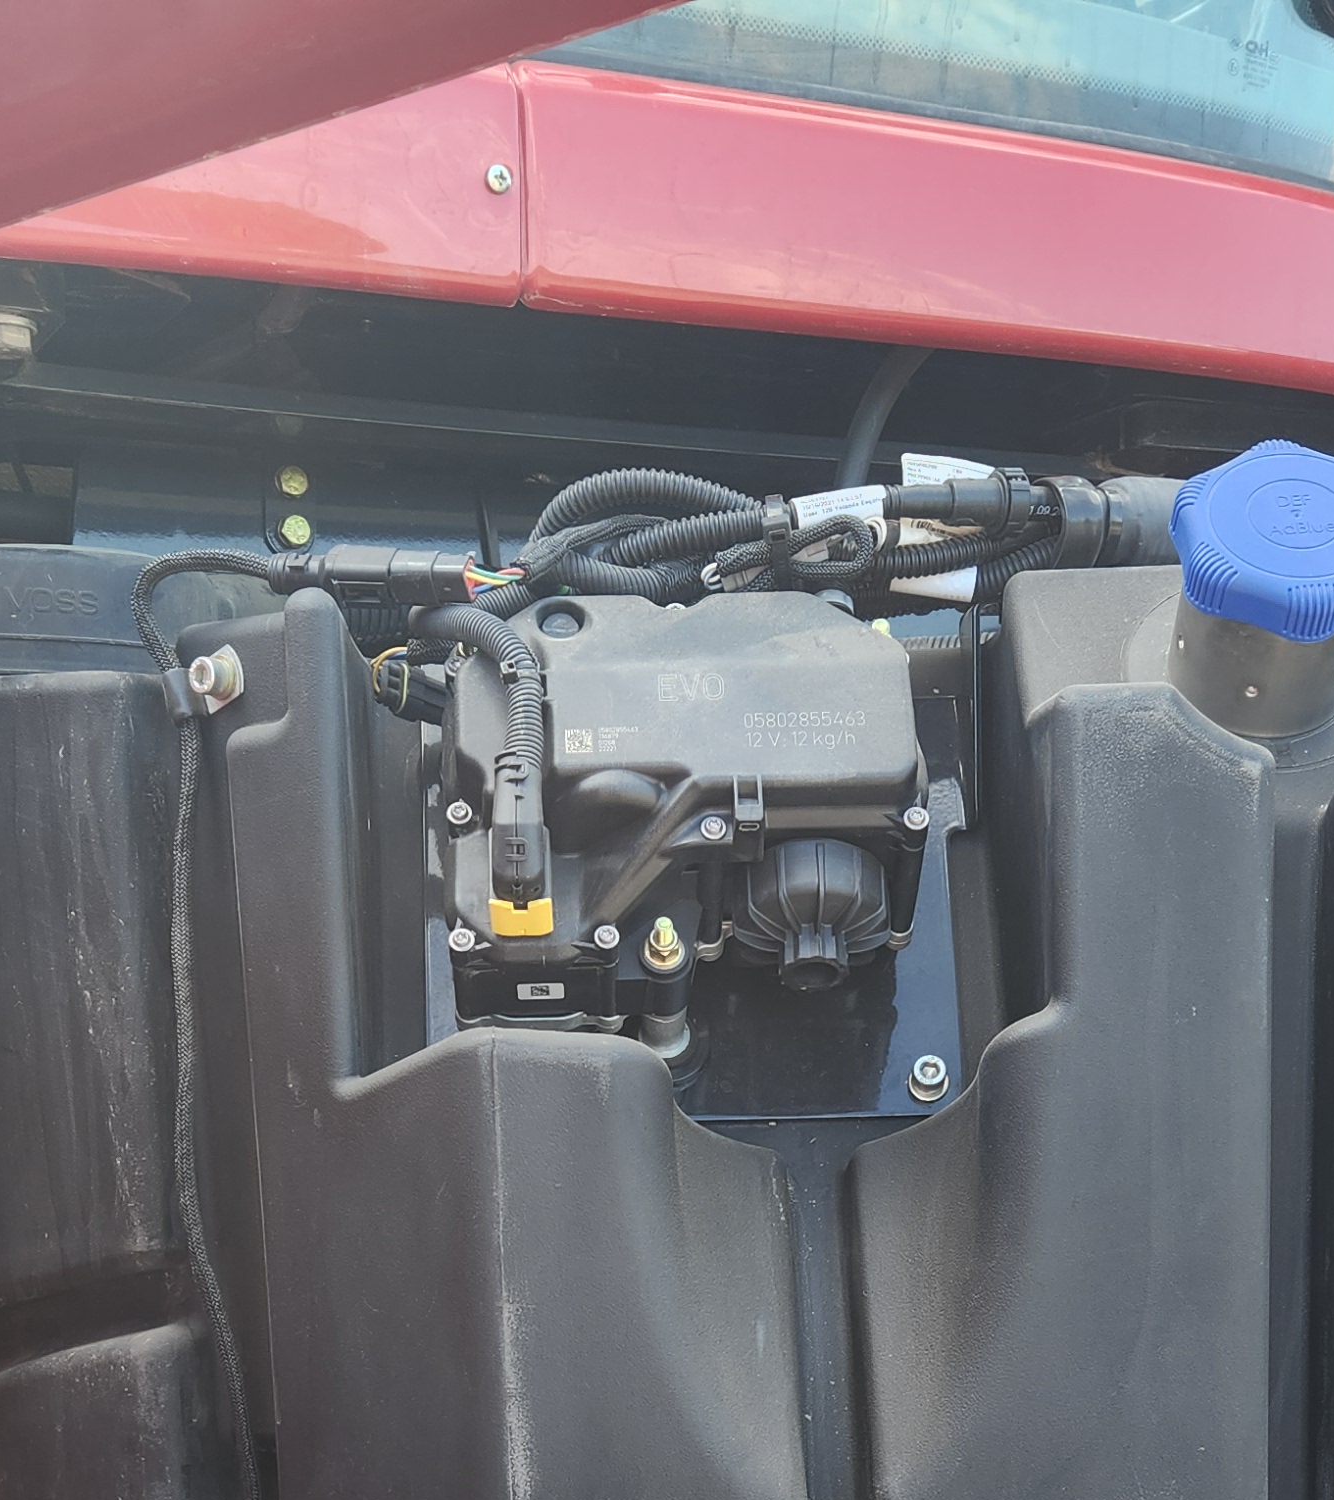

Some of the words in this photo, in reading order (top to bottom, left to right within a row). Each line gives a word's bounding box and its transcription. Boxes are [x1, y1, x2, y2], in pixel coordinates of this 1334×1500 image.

[1276, 494, 1311, 508] DEF
[3, 586, 99, 615] VOSS
[657, 672, 725, 702] EVO
[743, 710, 866, 729] 05802855463
[745, 732, 763, 748] 12
[791, 730, 808, 746] 12
[812, 730, 857, 750] kg/h
